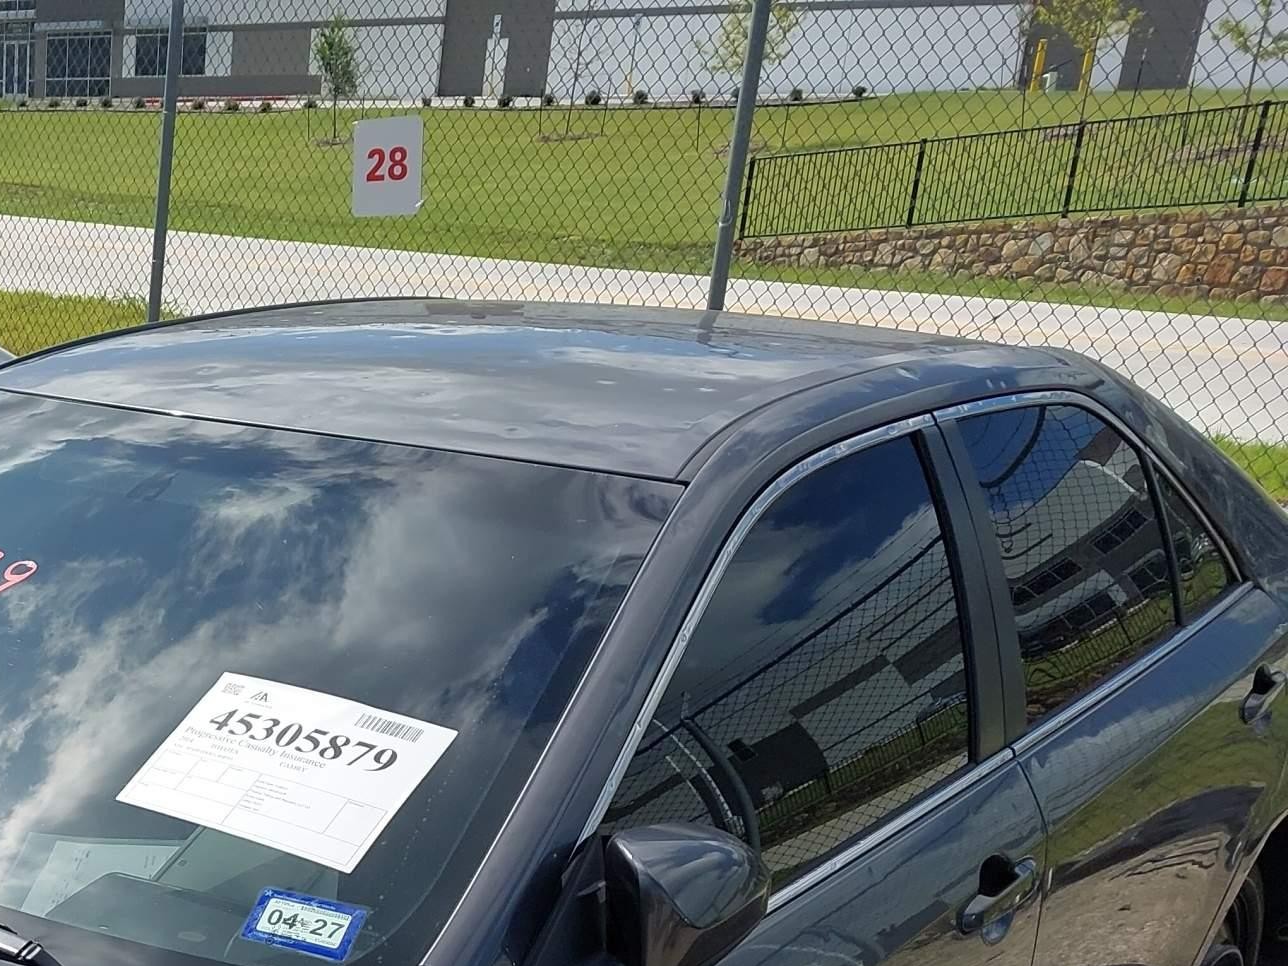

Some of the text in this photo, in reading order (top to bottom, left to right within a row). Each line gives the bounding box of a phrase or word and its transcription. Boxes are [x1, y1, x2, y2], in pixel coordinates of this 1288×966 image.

[366, 145, 408, 182] 28
[185, 726, 238, 745] Progressive
[238, 739, 277, 757] Casualty
[279, 750, 327, 769] Insurance
[209, 708, 399, 772] 45305879
[267, 909, 299, 930] 04
[309, 918, 346, 939] 27
